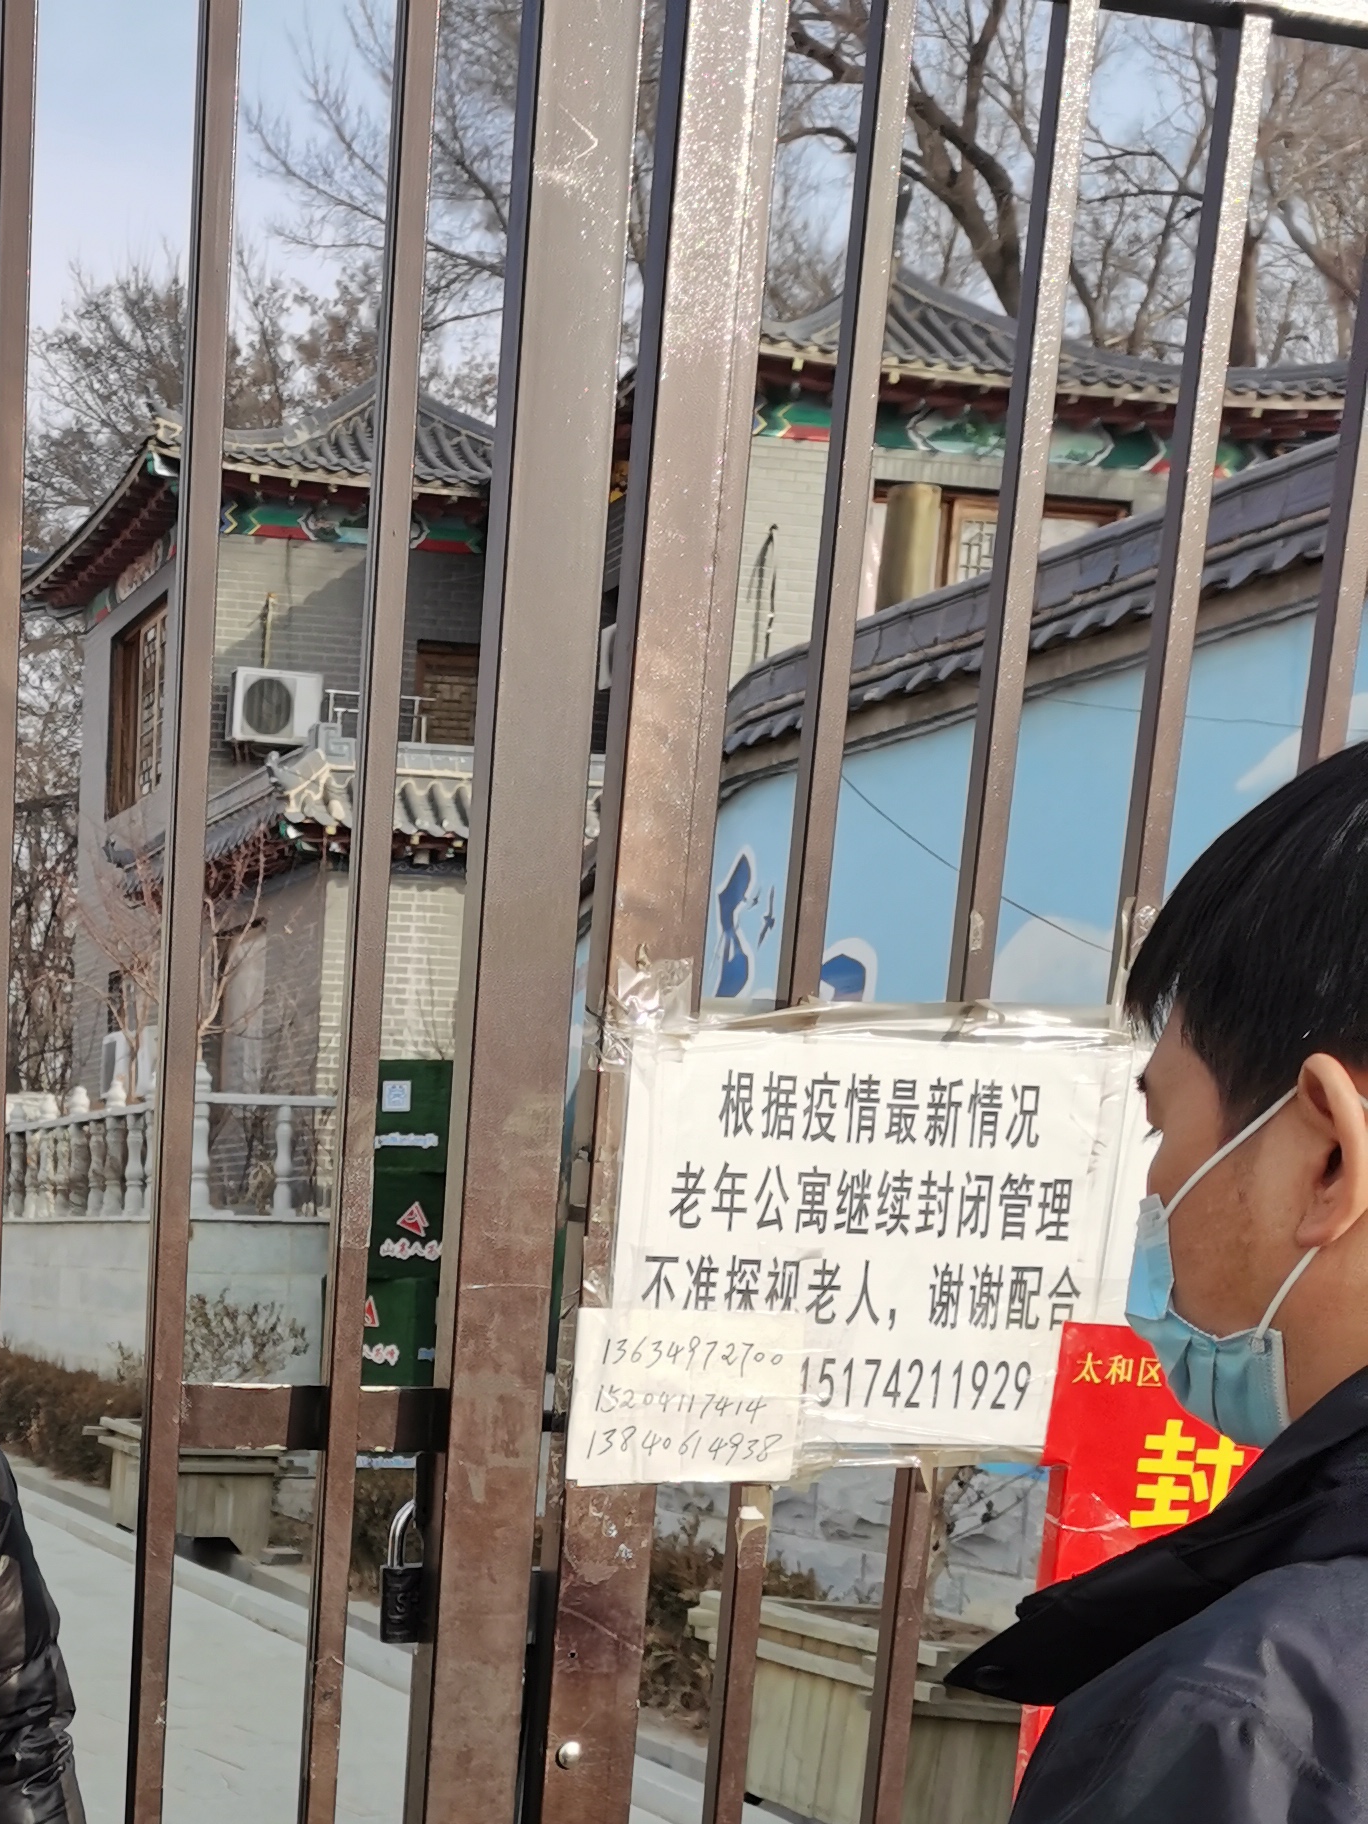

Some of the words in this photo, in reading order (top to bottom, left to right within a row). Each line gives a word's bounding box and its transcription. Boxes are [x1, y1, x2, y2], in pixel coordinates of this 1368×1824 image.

[718, 1068, 1041, 1150] 根据疫情最新情况
[668, 1160, 1073, 1243] 老年公寓继续封闭管理
[601, 1335, 784, 1378] 13634972700
[800, 1356, 1032, 1411] 15174211929
[1072, 1351, 1163, 1388] 太和区
[586, 1425, 784, 1466] 13840614938
[1129, 1418, 1246, 1529] 封
